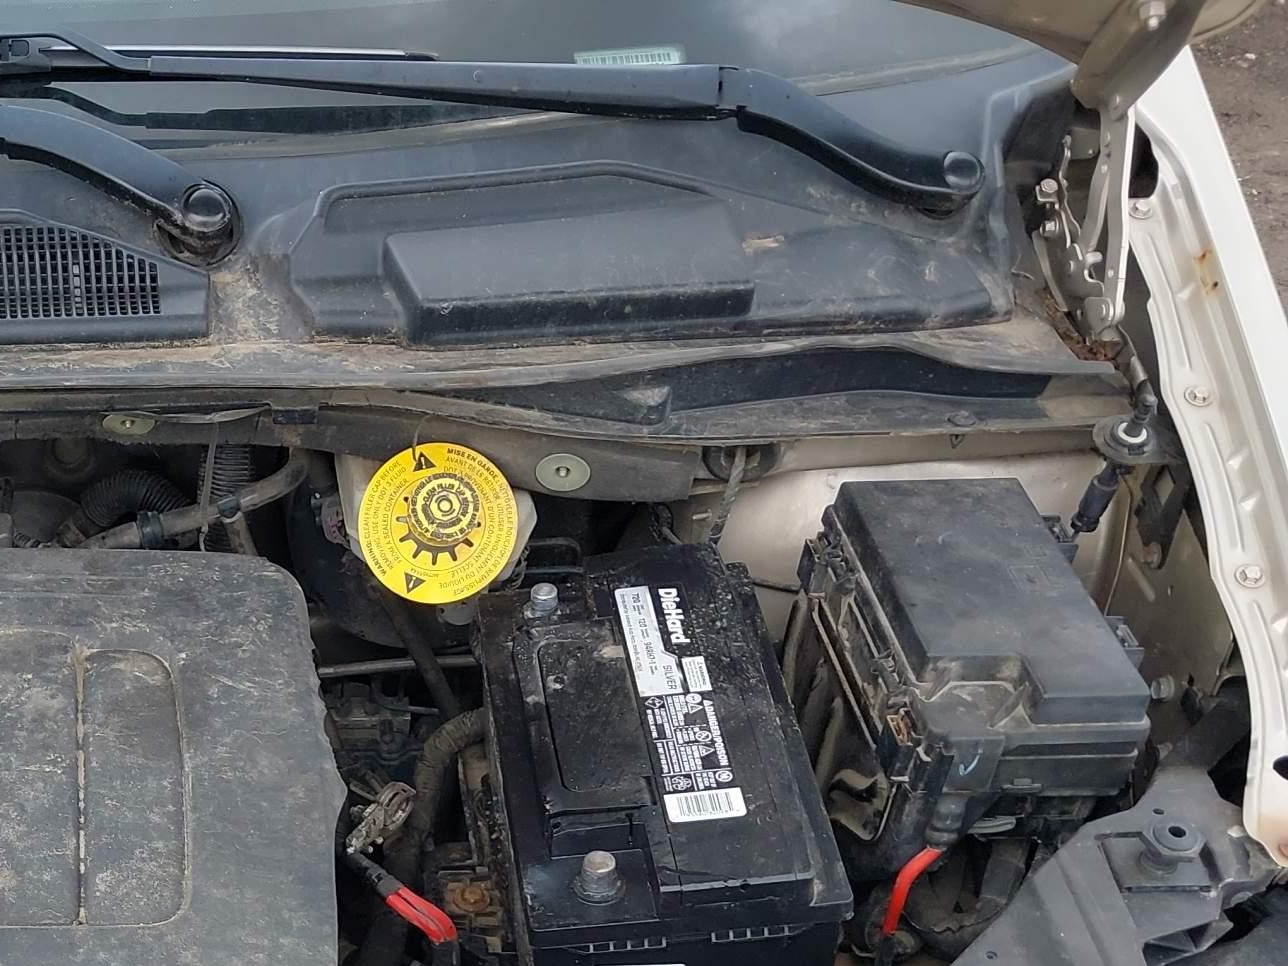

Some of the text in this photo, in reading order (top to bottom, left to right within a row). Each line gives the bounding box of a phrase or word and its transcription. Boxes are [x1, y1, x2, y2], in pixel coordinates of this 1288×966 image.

[446, 455, 467, 467] AVANT
[447, 448, 465, 457] MISE
[466, 453, 477, 462] EN
[378, 459, 402, 481] BEFORE
[370, 477, 384, 494] CAP
[372, 500, 382, 519] ONLY
[377, 486, 389, 501] DOT
[389, 467, 407, 483] FLUID
[383, 477, 409, 512] CONTAINER
[363, 514, 371, 539] CLEAN
[382, 513, 391, 539] SEALED
[365, 540, 388, 575] WARNING:
[658, 588, 691, 644] DieHard
[663, 665, 678, 690] SILVER
[705, 706, 729, 766] DANGER/POISON
